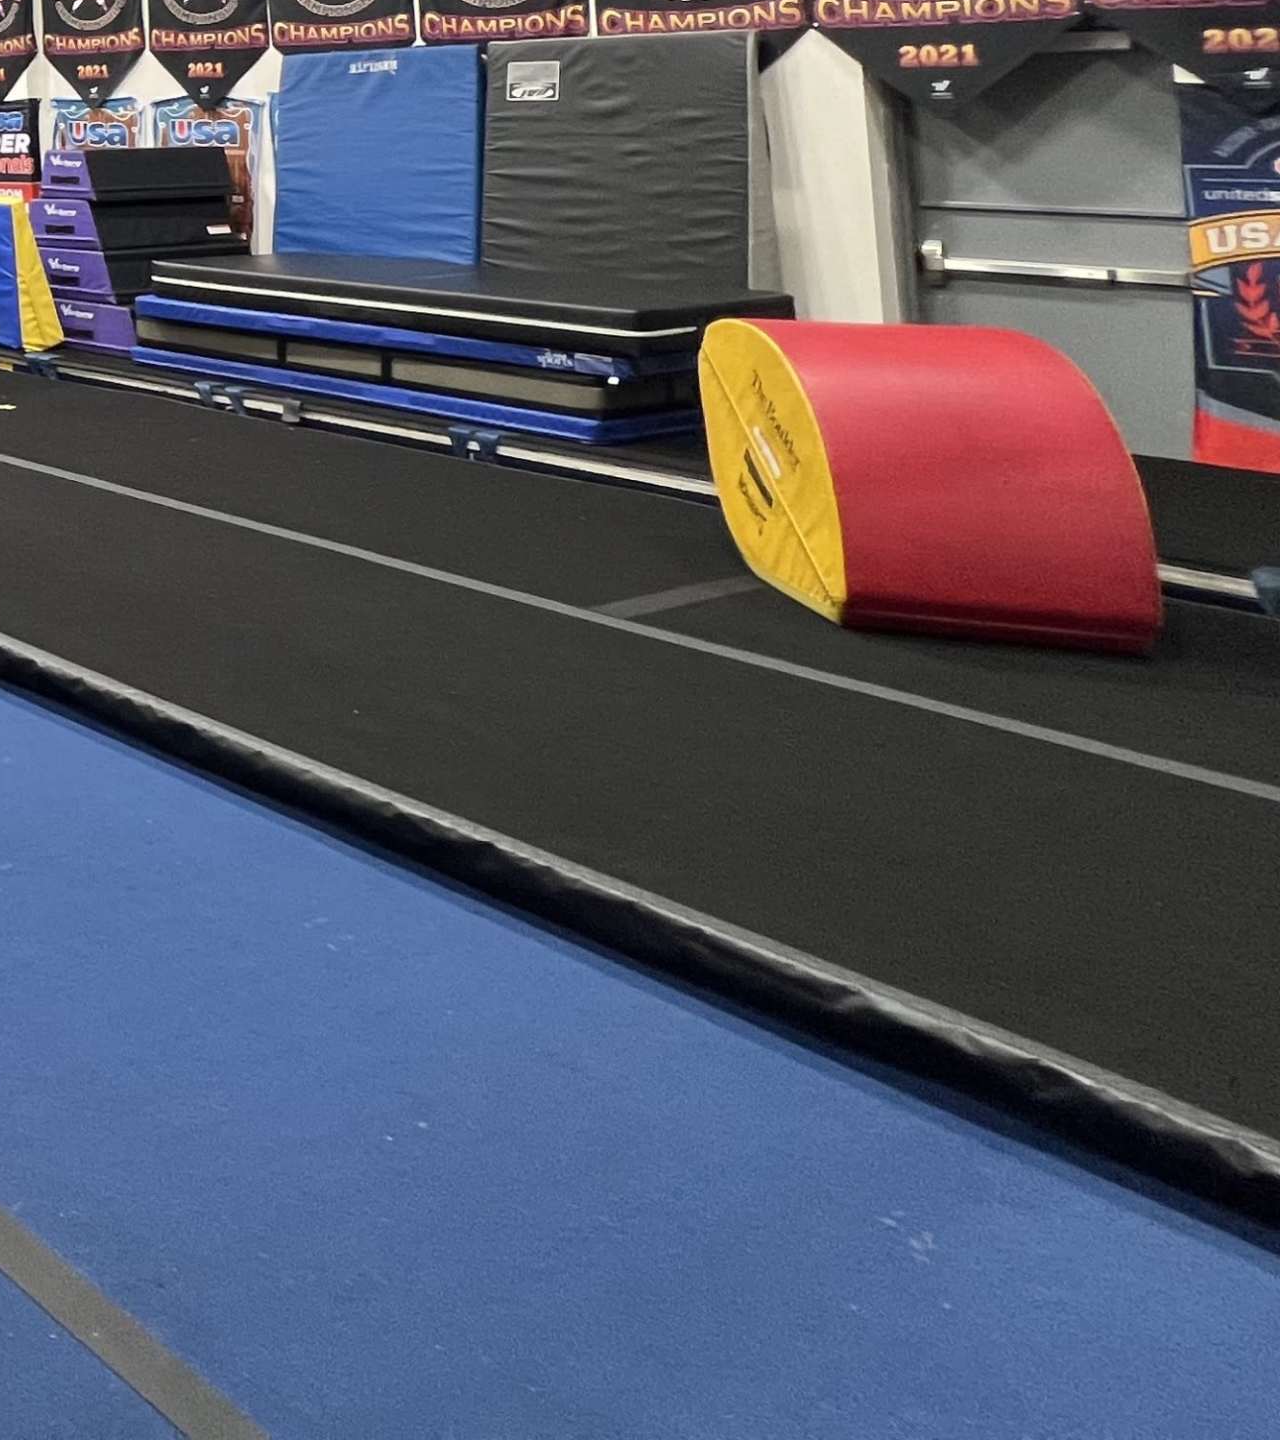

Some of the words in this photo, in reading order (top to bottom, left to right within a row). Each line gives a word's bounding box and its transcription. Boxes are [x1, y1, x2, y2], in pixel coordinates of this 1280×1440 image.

[273, 13, 410, 41] CHAMPIONS
[423, 4, 584, 35] CHAMPIONS
[44, 26, 141, 52] CHAMPIONS
[151, 23, 266, 47] CHAMPIONS
[898, 44, 978, 68] 2021
[187, 62, 224, 78] 2021
[1205, 221, 1280, 254] US
